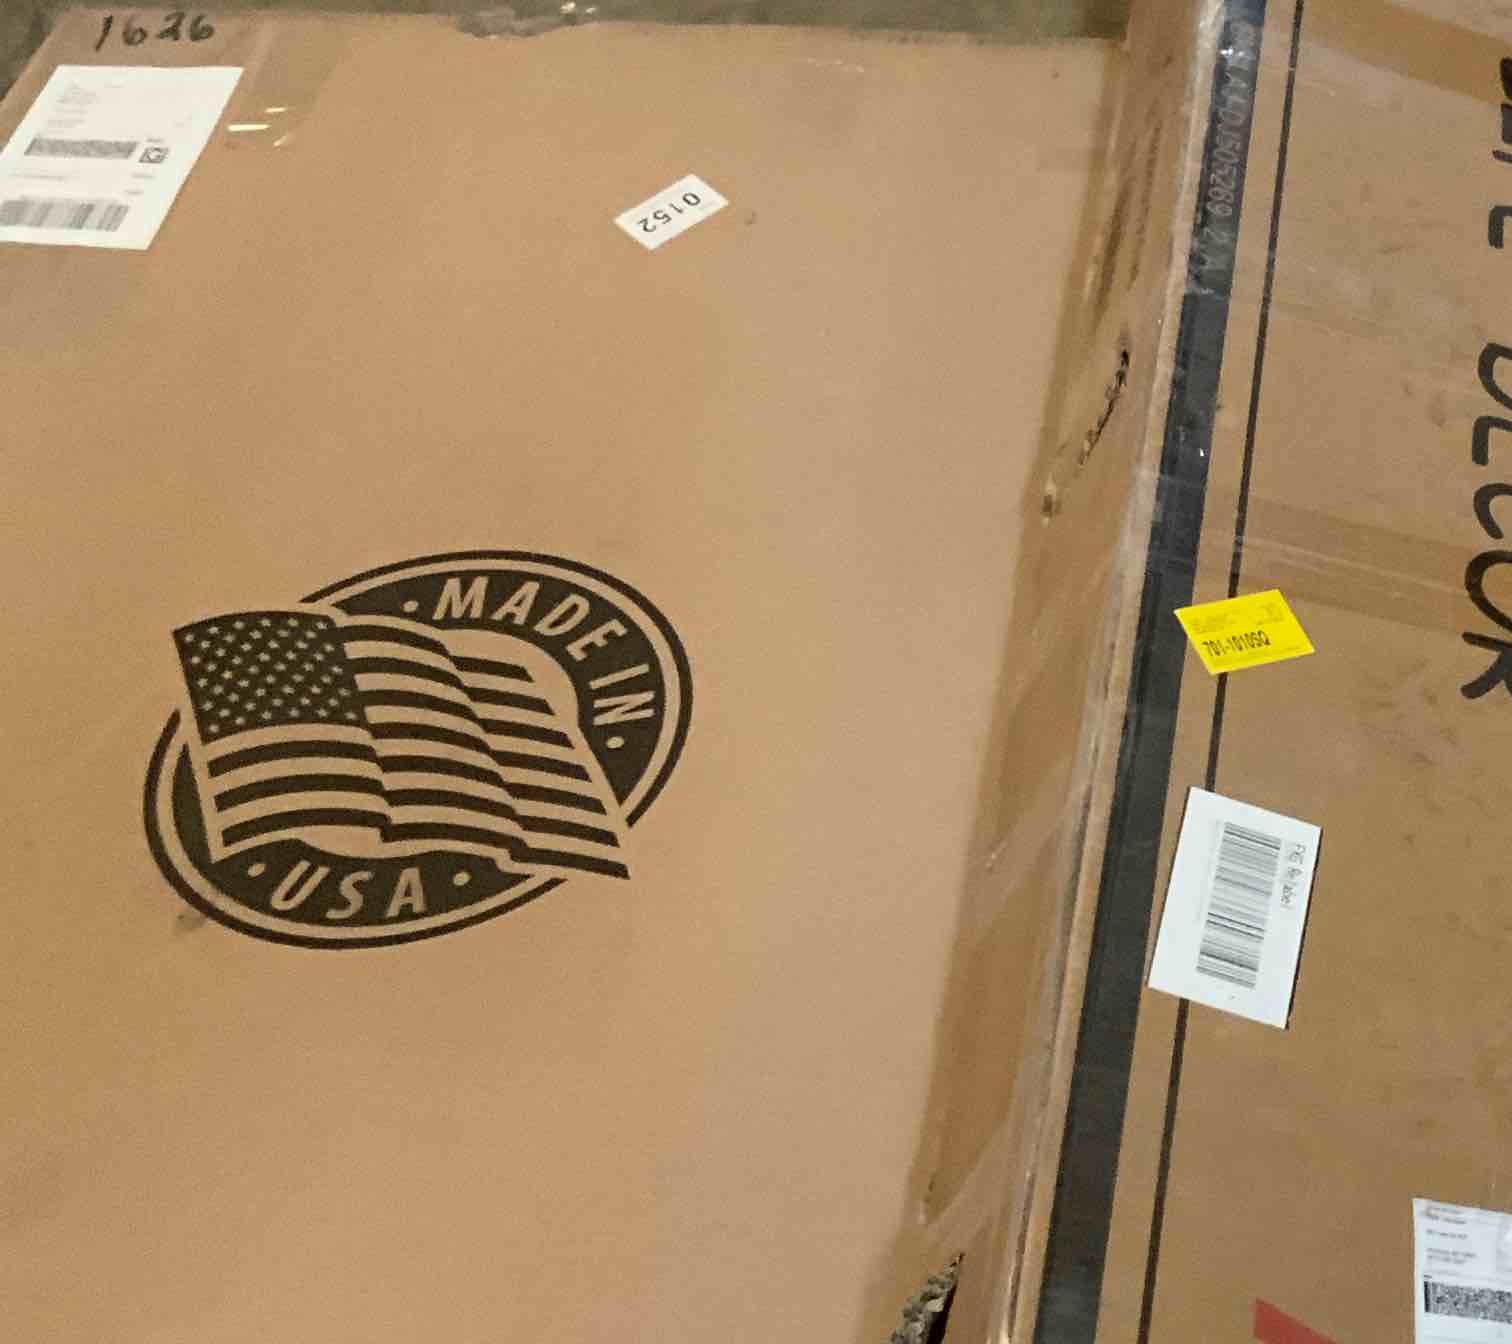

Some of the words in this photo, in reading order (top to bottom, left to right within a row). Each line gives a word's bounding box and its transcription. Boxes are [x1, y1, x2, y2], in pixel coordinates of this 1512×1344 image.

[635, 191, 702, 236] 0152
[431, 575, 628, 662] MADE
[588, 662, 656, 727] IN
[267, 860, 429, 921] USA
